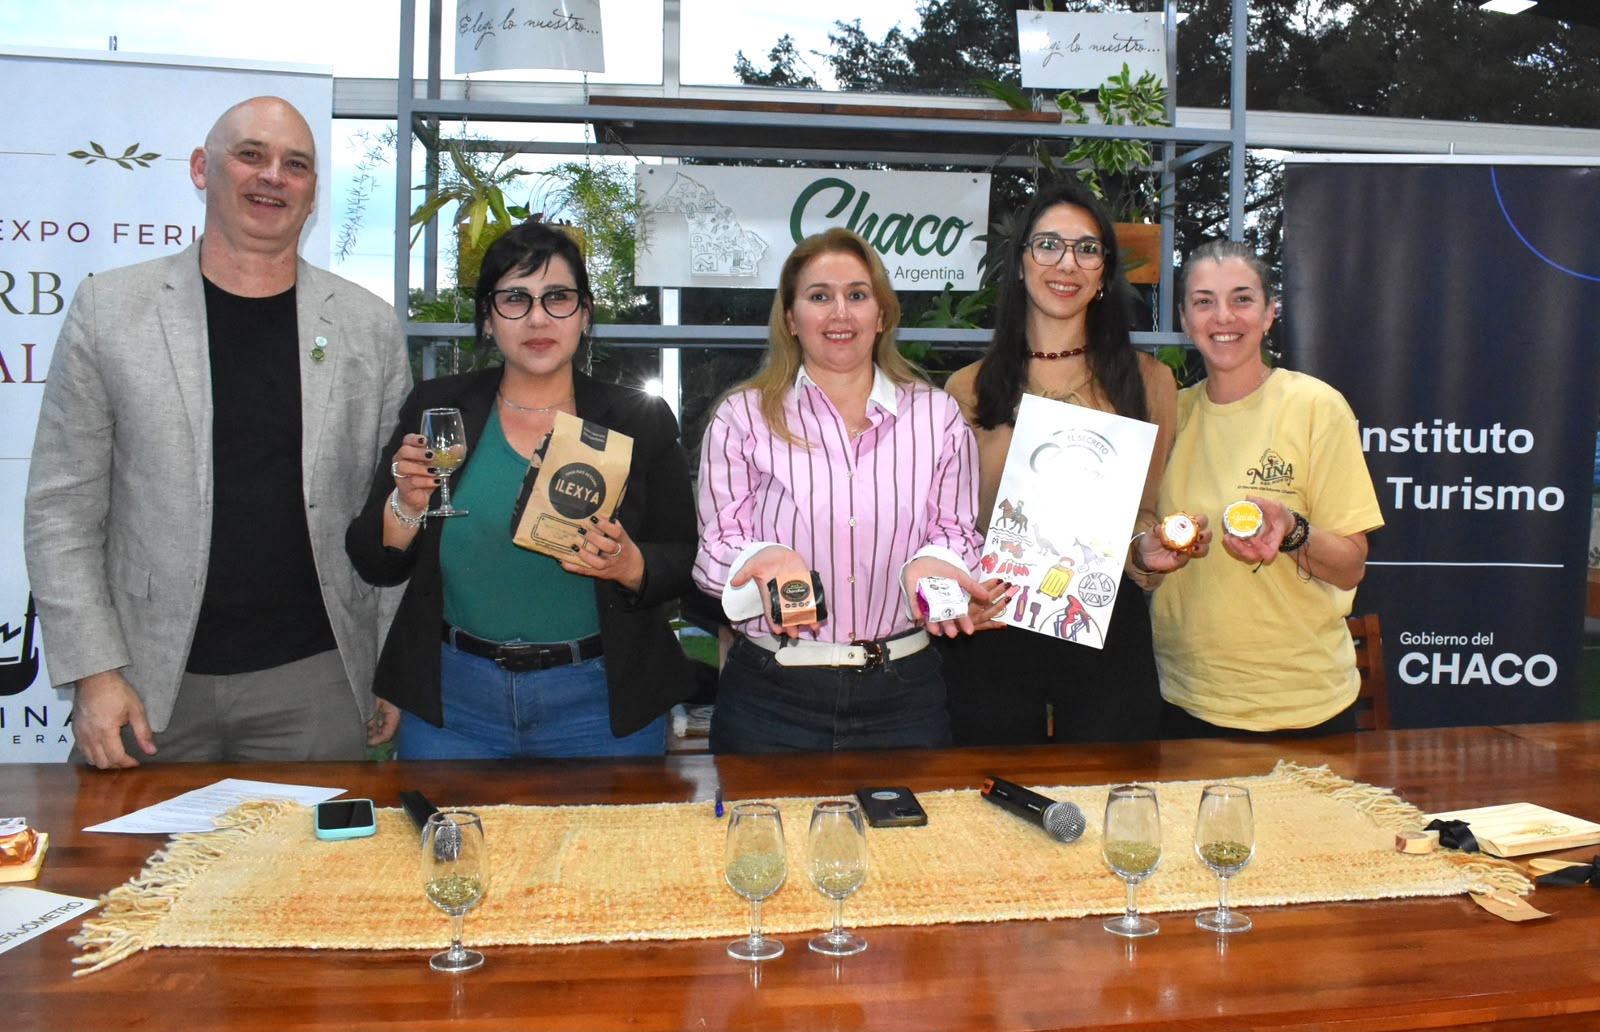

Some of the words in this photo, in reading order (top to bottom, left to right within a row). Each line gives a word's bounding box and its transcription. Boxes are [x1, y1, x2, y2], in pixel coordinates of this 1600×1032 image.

[498, 8, 517, 30] lo
[1067, 33, 1083, 52] lo
[790, 177, 974, 257] Chaco
[894, 266, 965, 282] Argentina
[1356, 419, 1535, 454] nstituto
[555, 479, 600, 505] ILEXYA
[1386, 477, 1565, 512] Turismo
[1400, 632, 1468, 645] Gobierno
[1471, 632, 1494, 645] del
[1398, 652, 1558, 687] CHACO
